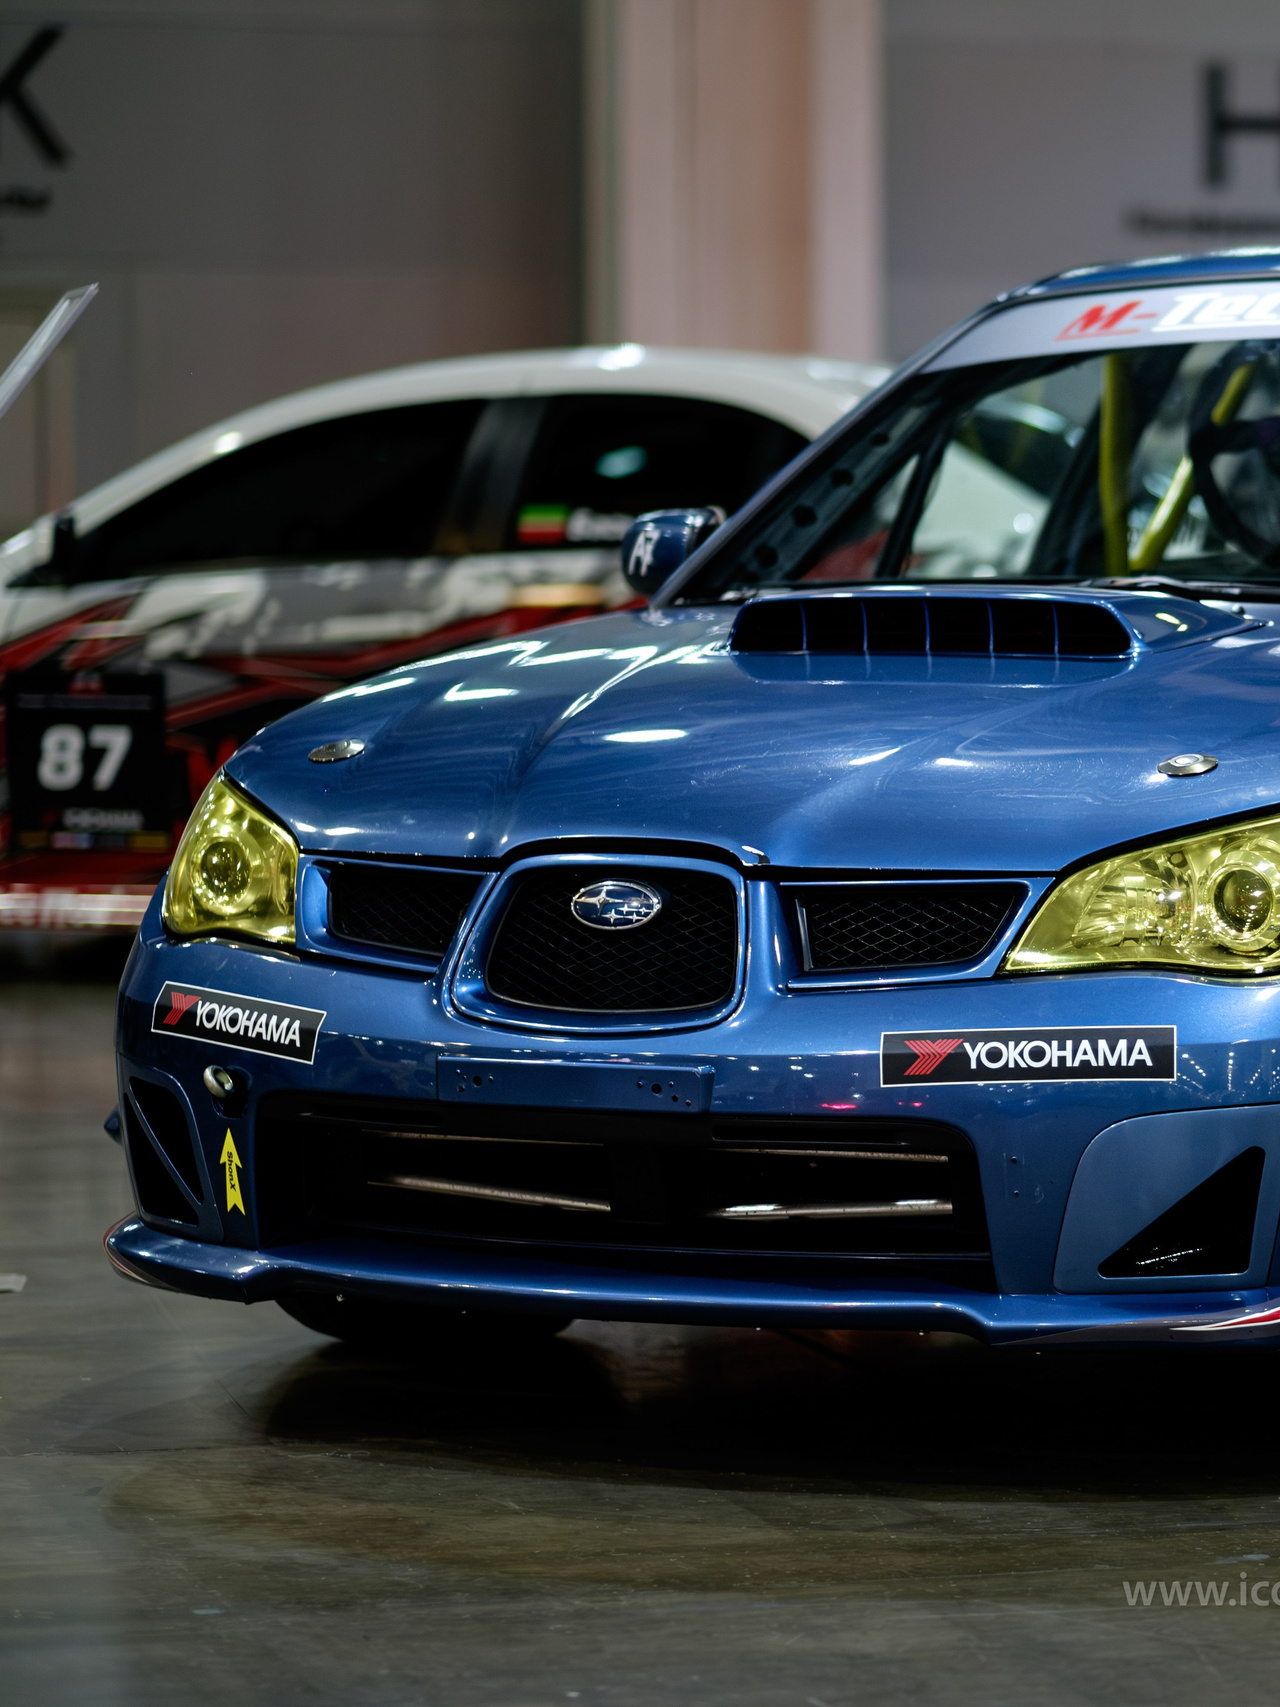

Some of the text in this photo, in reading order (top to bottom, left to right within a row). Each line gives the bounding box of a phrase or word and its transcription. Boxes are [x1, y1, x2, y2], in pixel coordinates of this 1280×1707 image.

[37, 723, 134, 791] 87
[195, 1000, 301, 1048] YOKOHAMA
[963, 1038, 1153, 1070] YOKOHAMA
